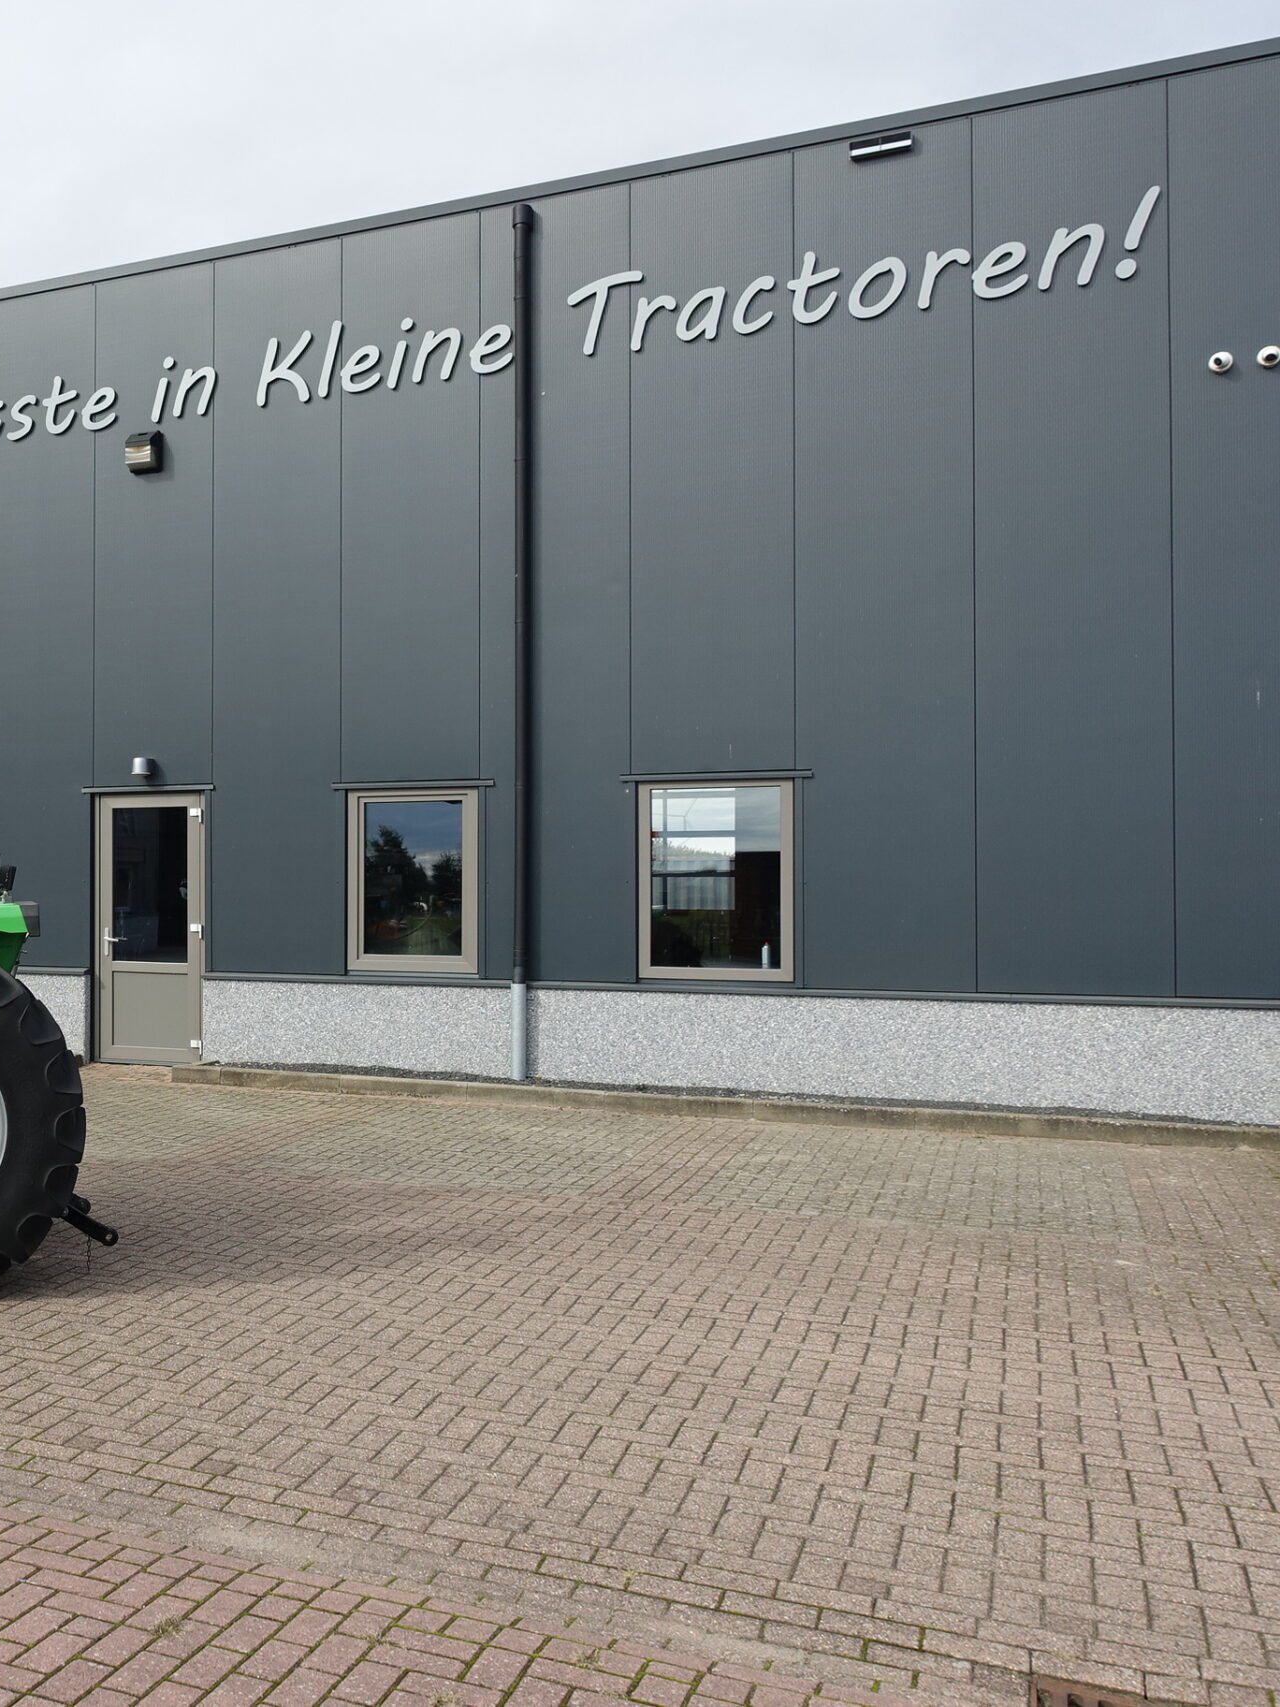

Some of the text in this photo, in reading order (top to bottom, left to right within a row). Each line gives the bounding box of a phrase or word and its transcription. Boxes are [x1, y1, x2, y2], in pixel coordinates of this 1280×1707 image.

[150, 355, 217, 421] in
[255, 319, 516, 408] Kleine
[565, 185, 1162, 357] Tractoren!
